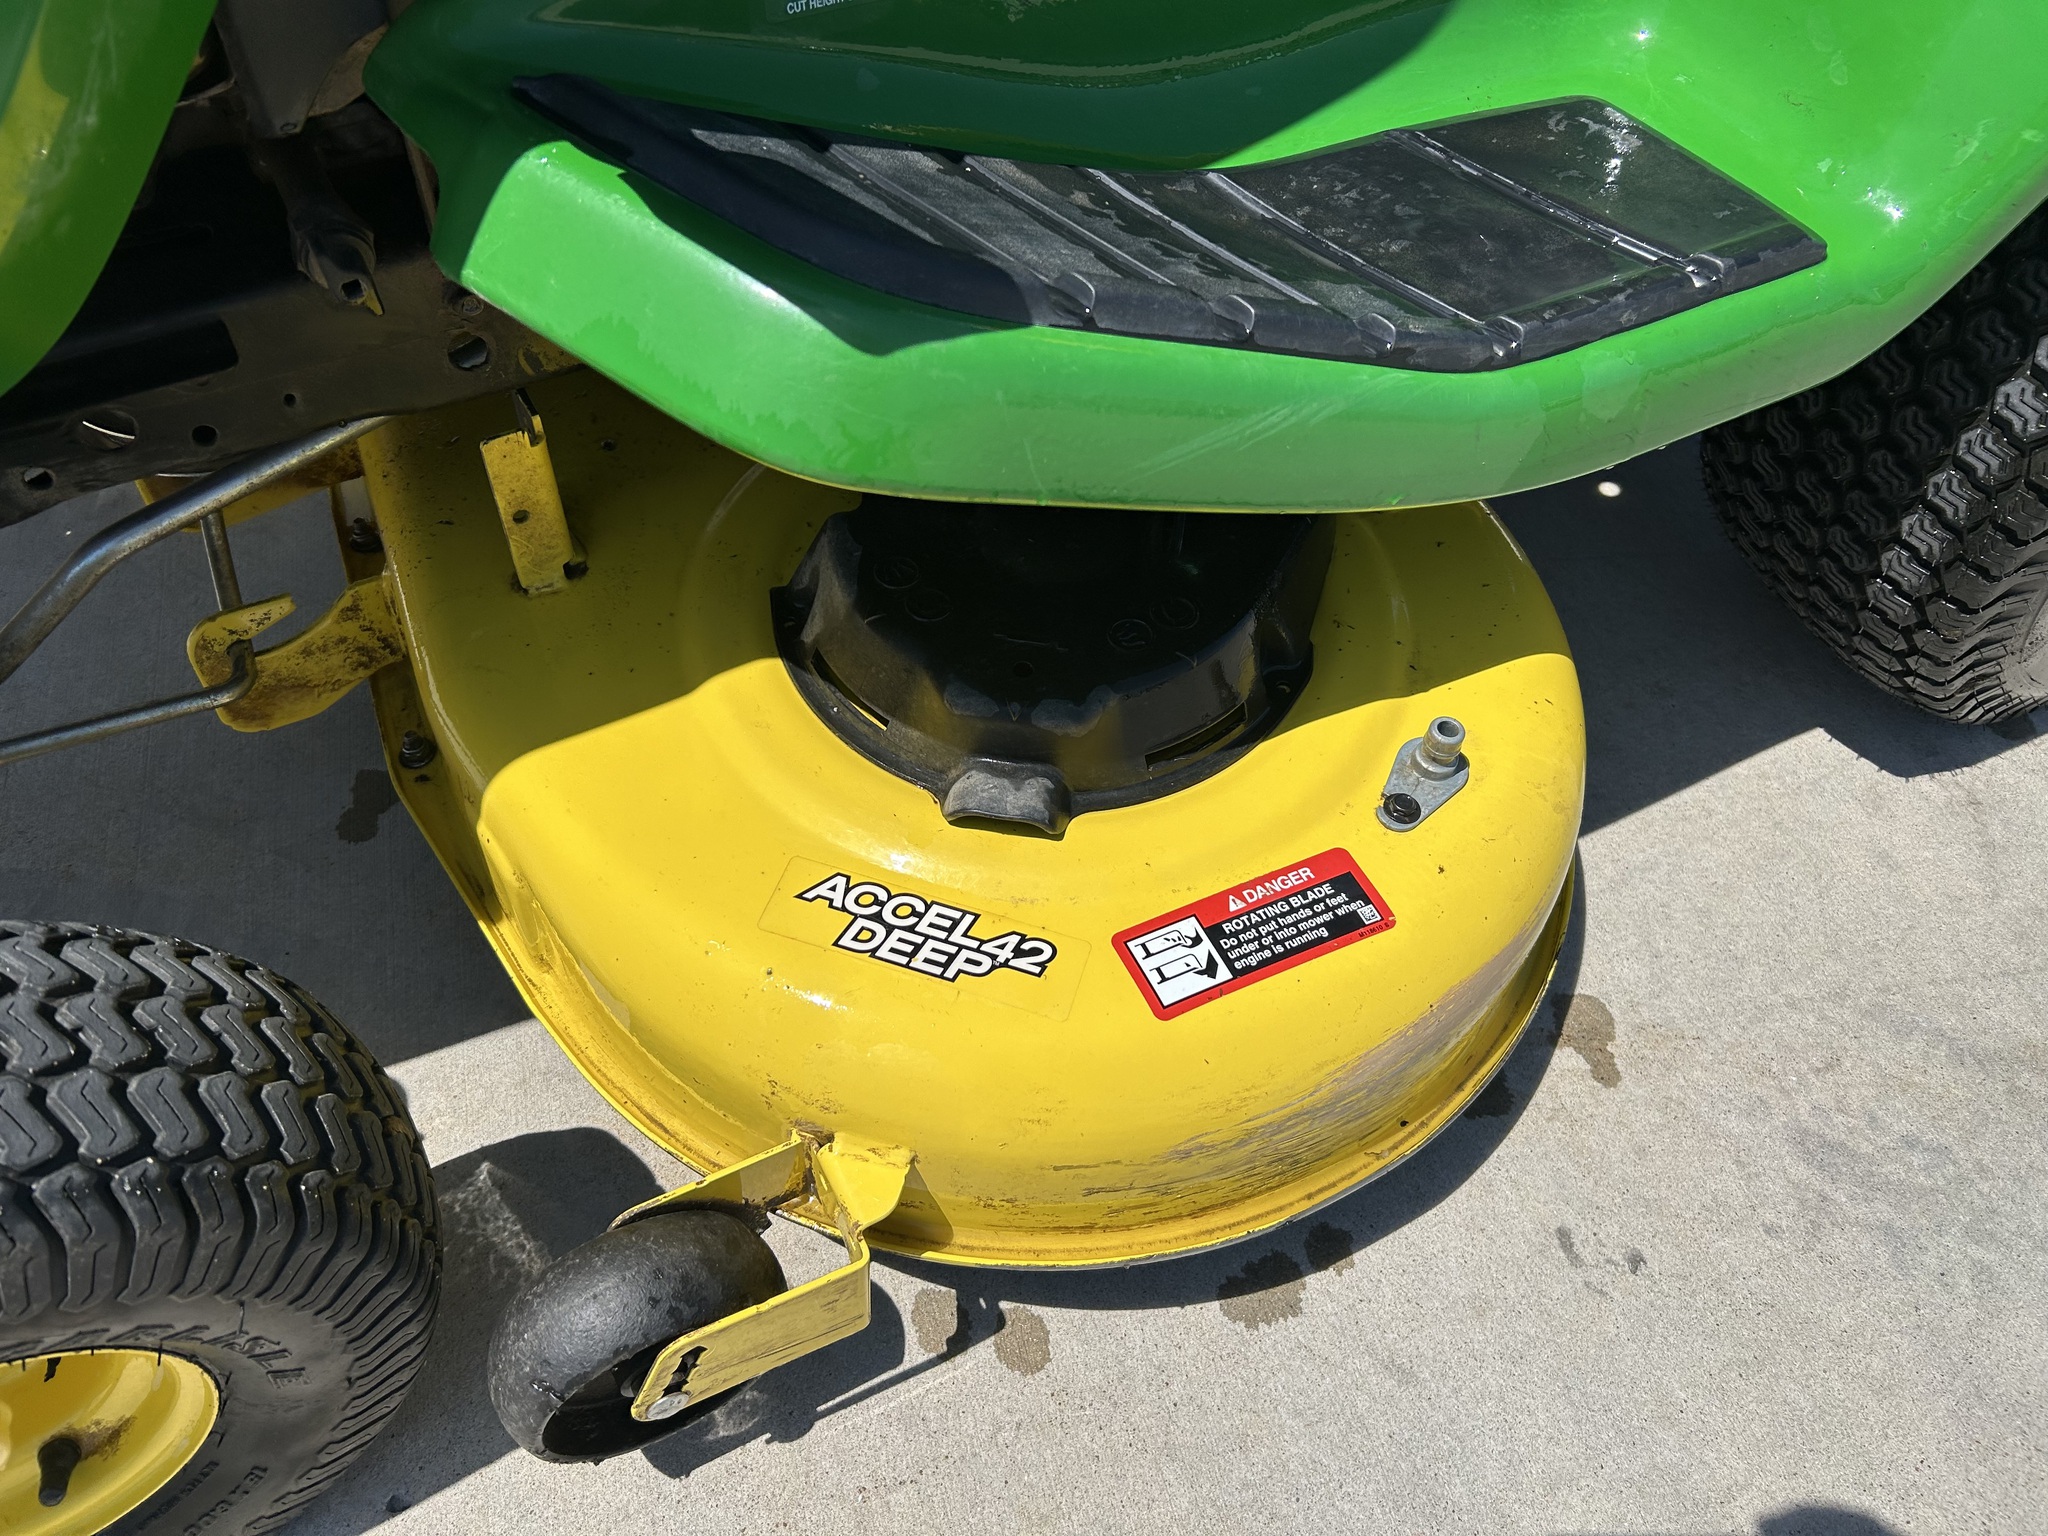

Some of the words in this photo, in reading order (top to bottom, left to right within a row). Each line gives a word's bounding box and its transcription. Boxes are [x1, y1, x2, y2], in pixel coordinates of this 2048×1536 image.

[786, 0, 807, 15] CUT
[1221, 901, 1290, 935] ROTATING
[1288, 883, 1336, 908] BLADE
[1242, 867, 1316, 903] DANGER
[793, 872, 982, 950] ACCEL
[979, 930, 1058, 978] 42
[1219, 938, 1239, 950] Do
[1238, 927, 1261, 943] not
[1259, 919, 1280, 936] put
[1276, 907, 1314, 927] hands
[1312, 903, 1327, 913] or
[1325, 892, 1350, 908] feet
[1226, 939, 1261, 960] under
[1261, 933, 1276, 946] or
[1273, 924, 1299, 941] into
[1297, 911, 1336, 932] mower
[1334, 899, 1367, 917] when
[1233, 948, 1274, 970] engine
[1271, 943, 1286, 955] is
[1283, 926, 1330, 950] running
[831, 915, 994, 983] DEEP
